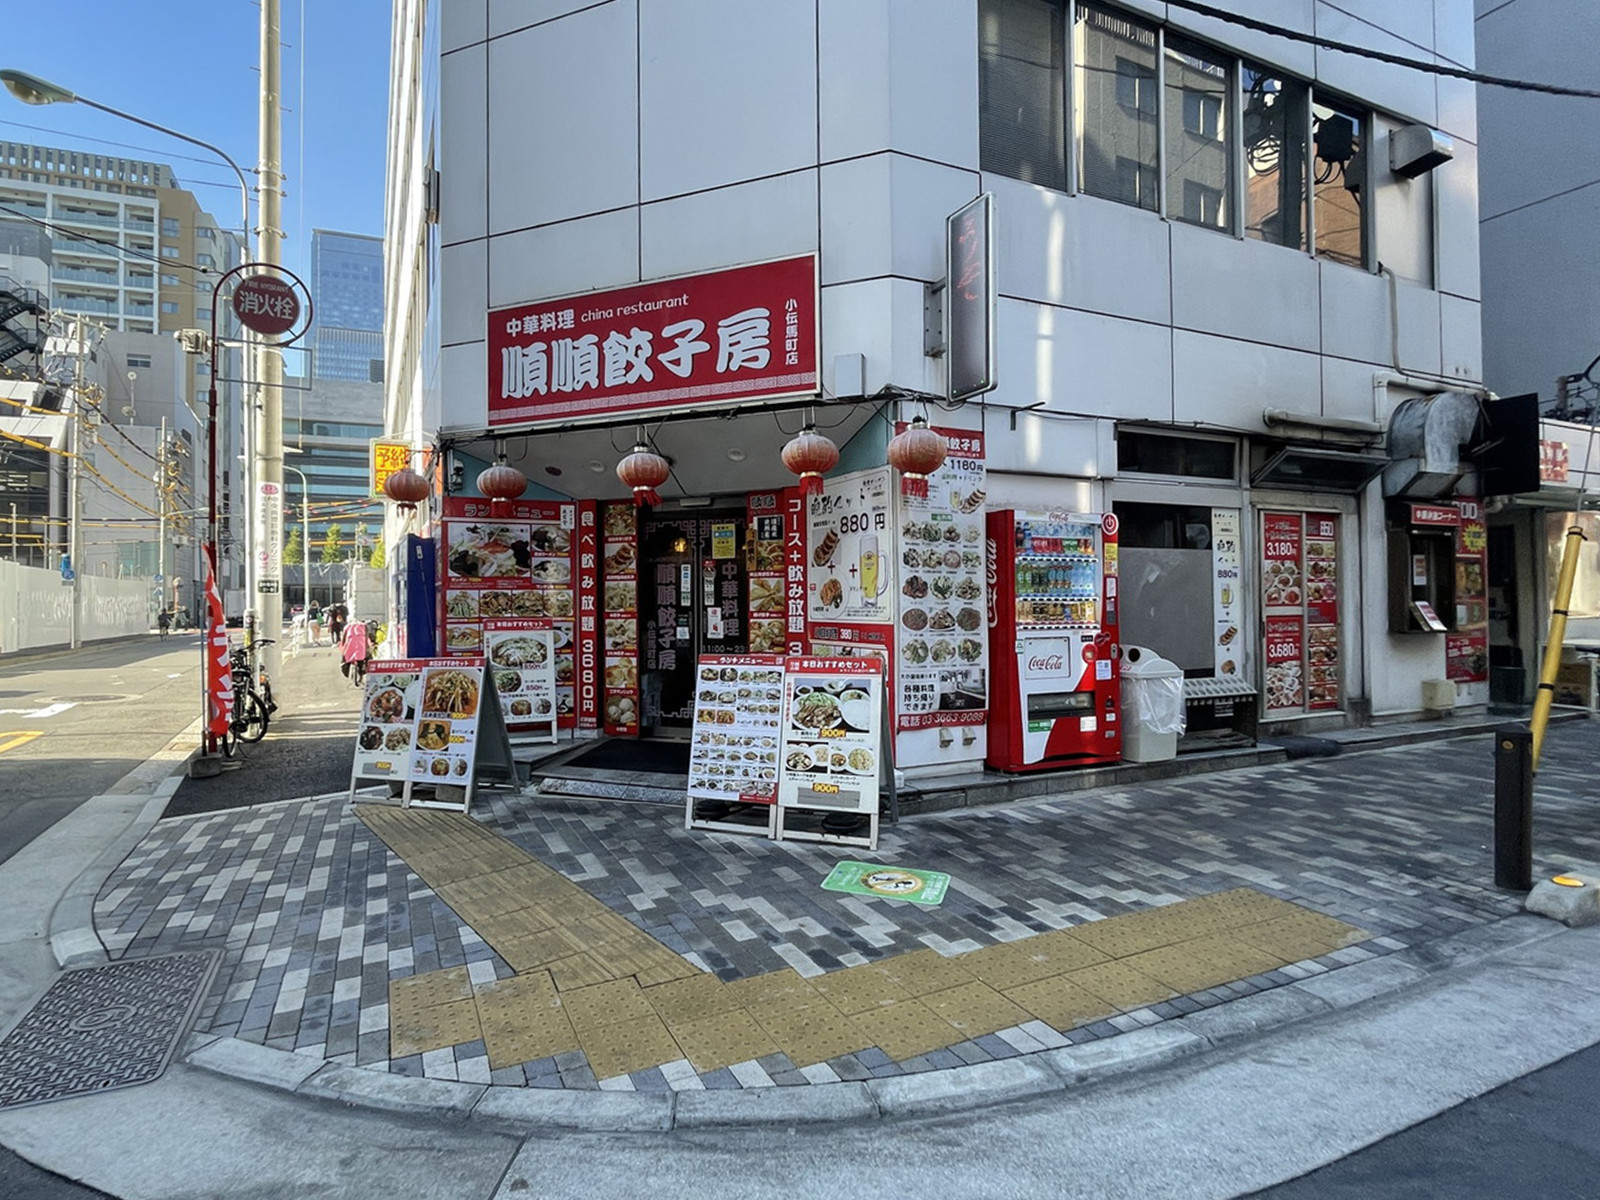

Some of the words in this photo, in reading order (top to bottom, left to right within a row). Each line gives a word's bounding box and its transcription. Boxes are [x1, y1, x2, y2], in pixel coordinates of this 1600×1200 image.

[244, 280, 259, 289] FIRE
[240, 290, 294, 320] 消火栓
[581, 307, 613, 323] china
[616, 293, 689, 317] restaurant
[506, 308, 575, 338] 中華料理
[785, 298, 798, 366] 小伝馬町店
[501, 307, 771, 399] 順順餃子房
[464, 503, 556, 519] ランニュー
[840, 512, 885, 534] 880円
[581, 510, 595, 632] 食べ飲み放題
[722, 561, 739, 636] 中華料理
[657, 563, 677, 670] 順順餃子房
[720, 656, 763, 665] ランチメニュー
[802, 660, 868, 669] 本日おすすめセット
[1028, 655, 1063, 671] Coca-Cola
[582, 639, 594, 712] 3680円
[904, 702, 934, 711] できます
[821, 728, 845, 737] 900円
[900, 715, 920, 728] 電話
[814, 783, 839, 793] 900円
